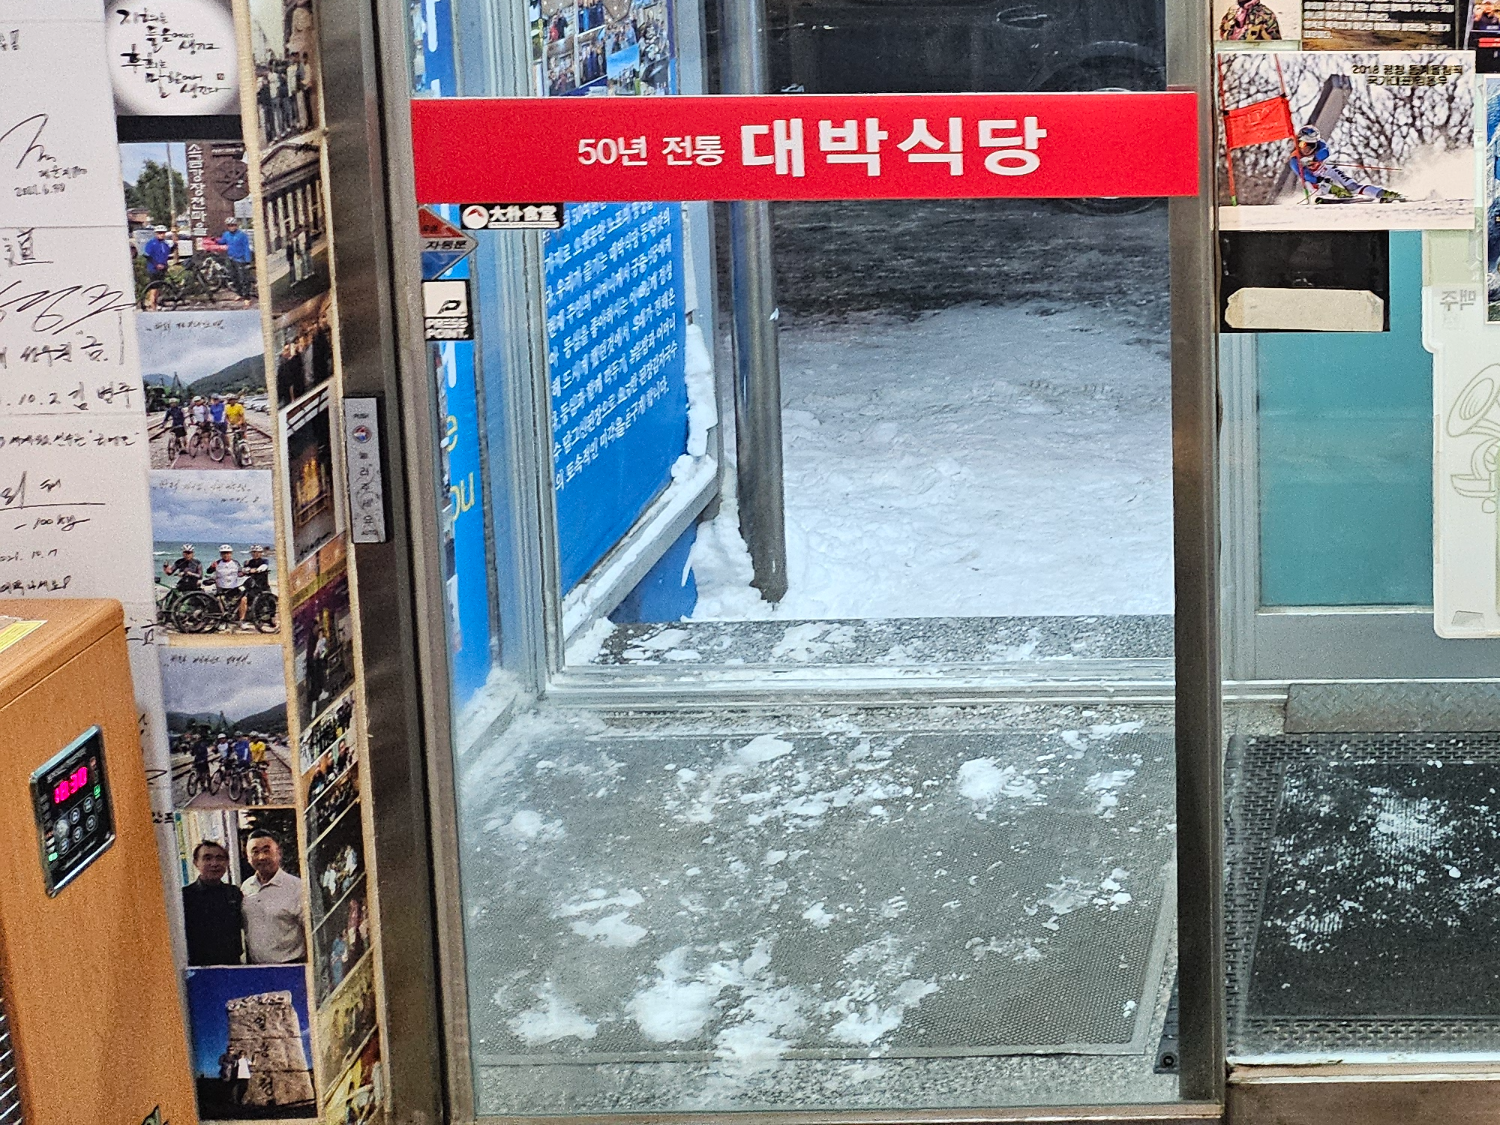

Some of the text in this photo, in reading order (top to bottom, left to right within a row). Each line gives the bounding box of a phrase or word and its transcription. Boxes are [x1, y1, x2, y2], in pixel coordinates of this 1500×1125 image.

[1352, 64, 1380, 75] 2018
[577, 115, 1048, 177] 50년 전통 대박식당
[489, 204, 558, 222] 大朴食堂
[425, 240, 468, 250] 자동문
[425, 318, 469, 329] PRESS
